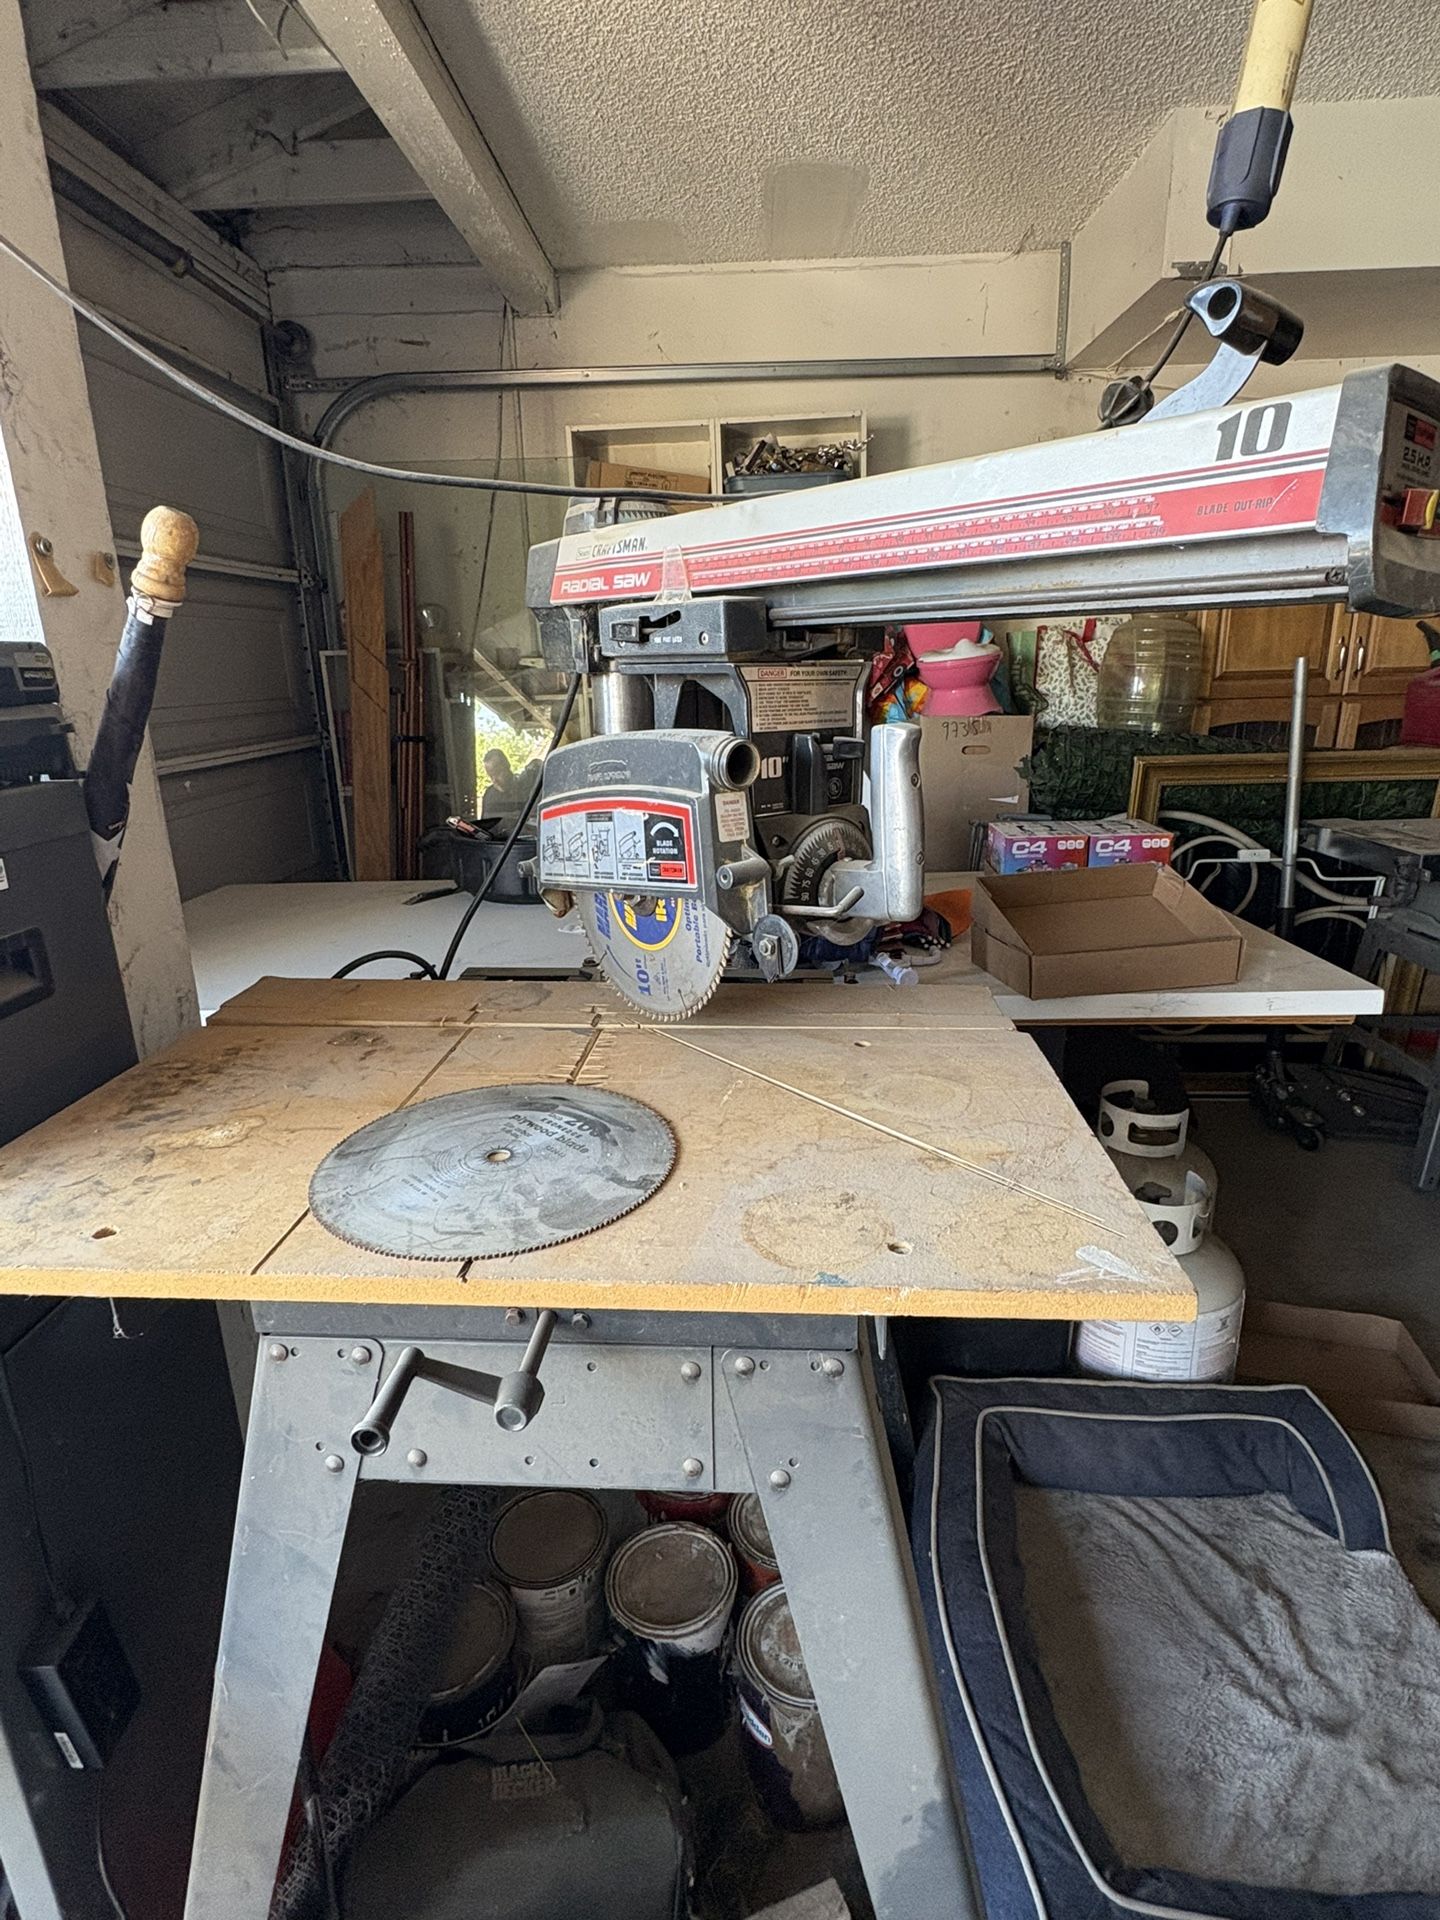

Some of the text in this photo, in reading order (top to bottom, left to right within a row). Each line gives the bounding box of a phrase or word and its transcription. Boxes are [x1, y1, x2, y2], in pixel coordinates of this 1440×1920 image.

[1215, 401, 1292, 462] 10
[1196, 503, 1228, 516] BLADE
[1011, 840, 1048, 854] C4
[1095, 838, 1132, 853] C4
[691, 914, 703, 963] Portable
[508, 1114, 559, 1137] plywood
[555, 1134, 589, 1154] blade
